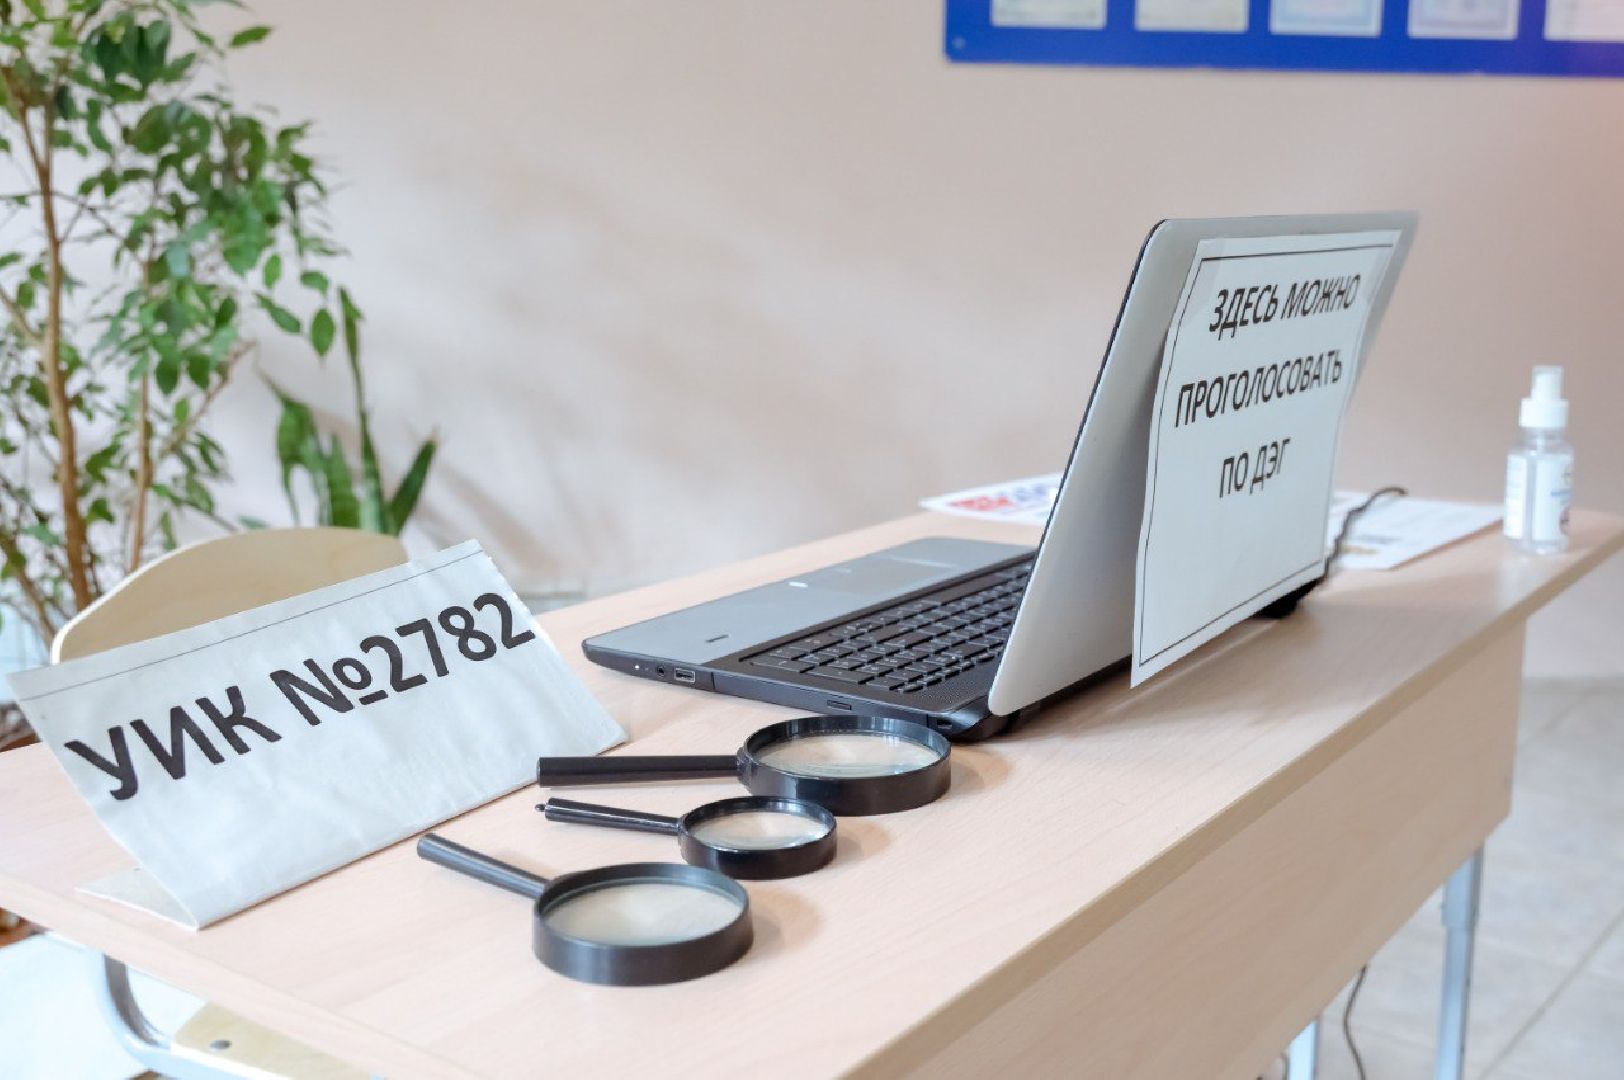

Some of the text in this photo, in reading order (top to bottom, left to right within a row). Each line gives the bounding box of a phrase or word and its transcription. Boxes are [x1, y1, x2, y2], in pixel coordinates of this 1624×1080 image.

[1209, 274, 1361, 341] ЗДЕСЬ МОЖНО
[1175, 350, 1343, 428] ПРОГОЛОСОВАТЬ
[1219, 438, 1291, 498] ПО ДЭГ
[64, 592, 536, 801] УИК №2782
